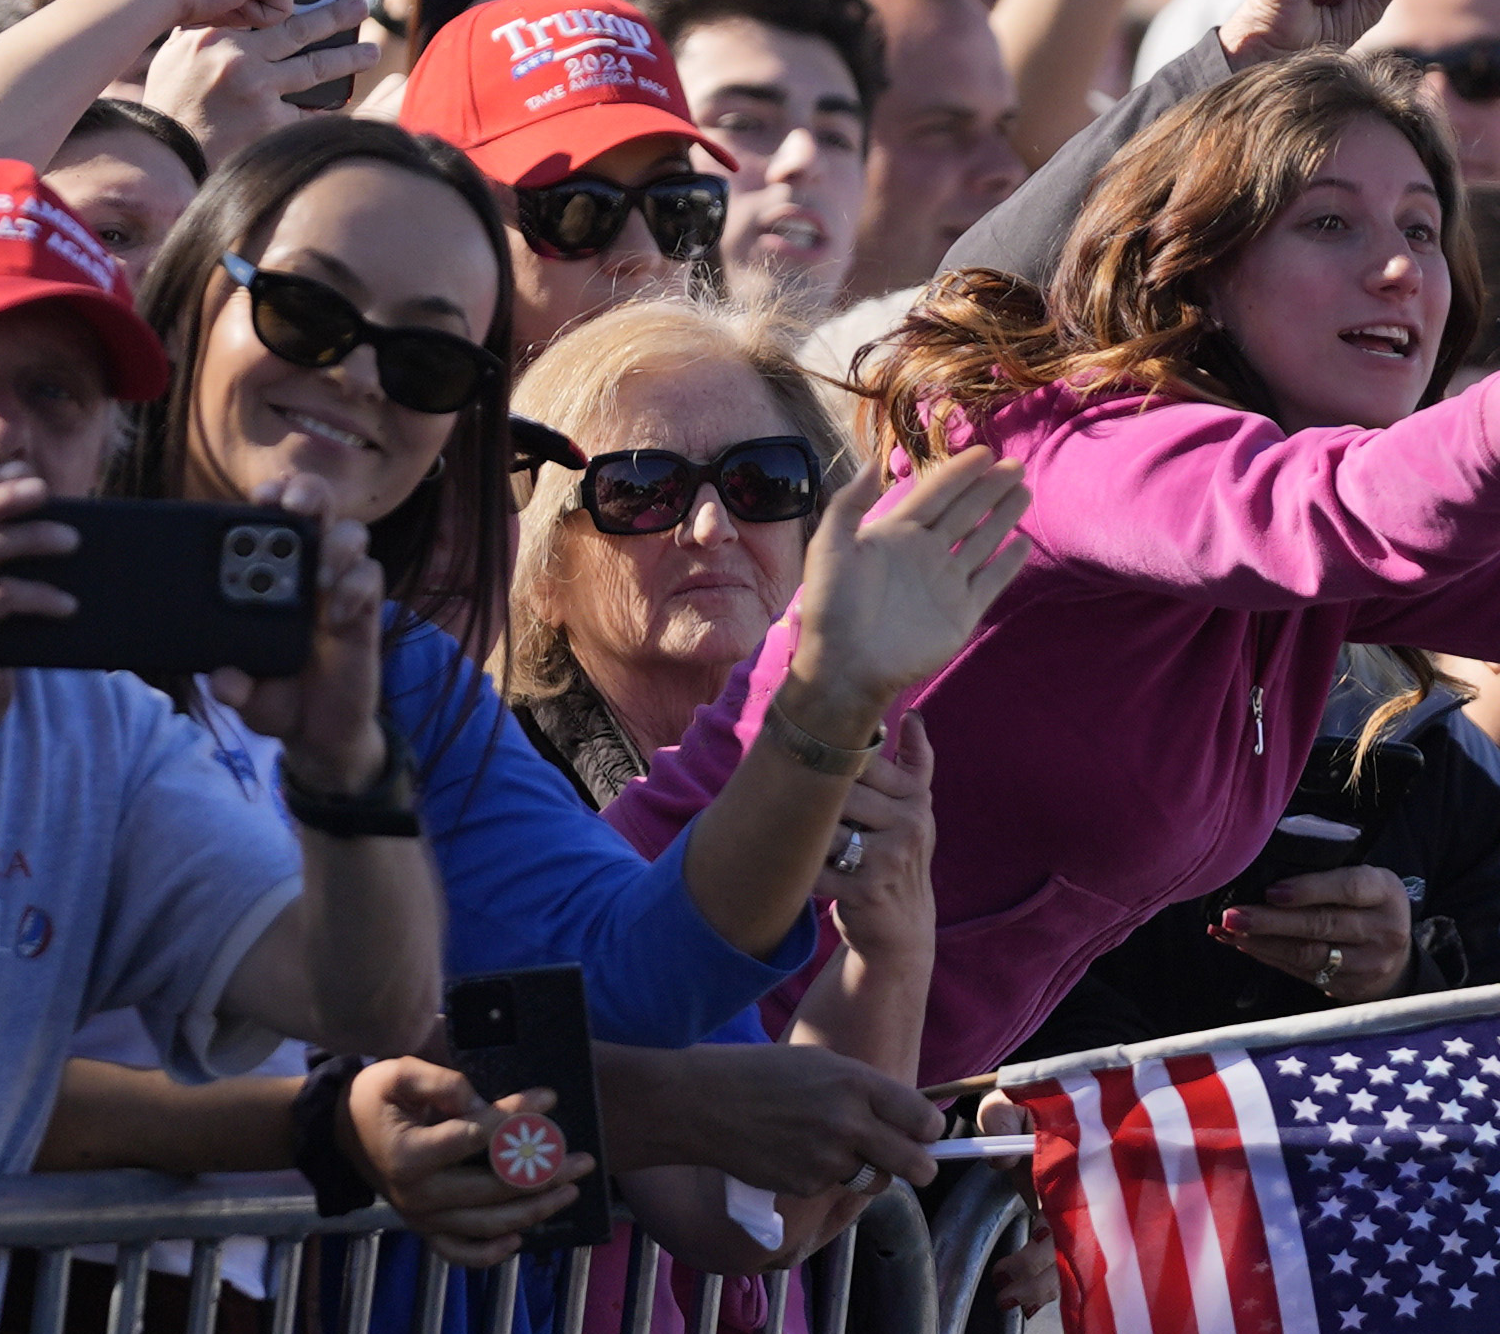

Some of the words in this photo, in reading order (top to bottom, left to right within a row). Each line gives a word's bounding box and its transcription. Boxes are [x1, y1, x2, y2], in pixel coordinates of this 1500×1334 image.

[490, 7, 654, 62] Trump
[563, 53, 634, 79] 2024
[524, 83, 567, 112] TAKE
[569, 71, 636, 94] AMERICA
